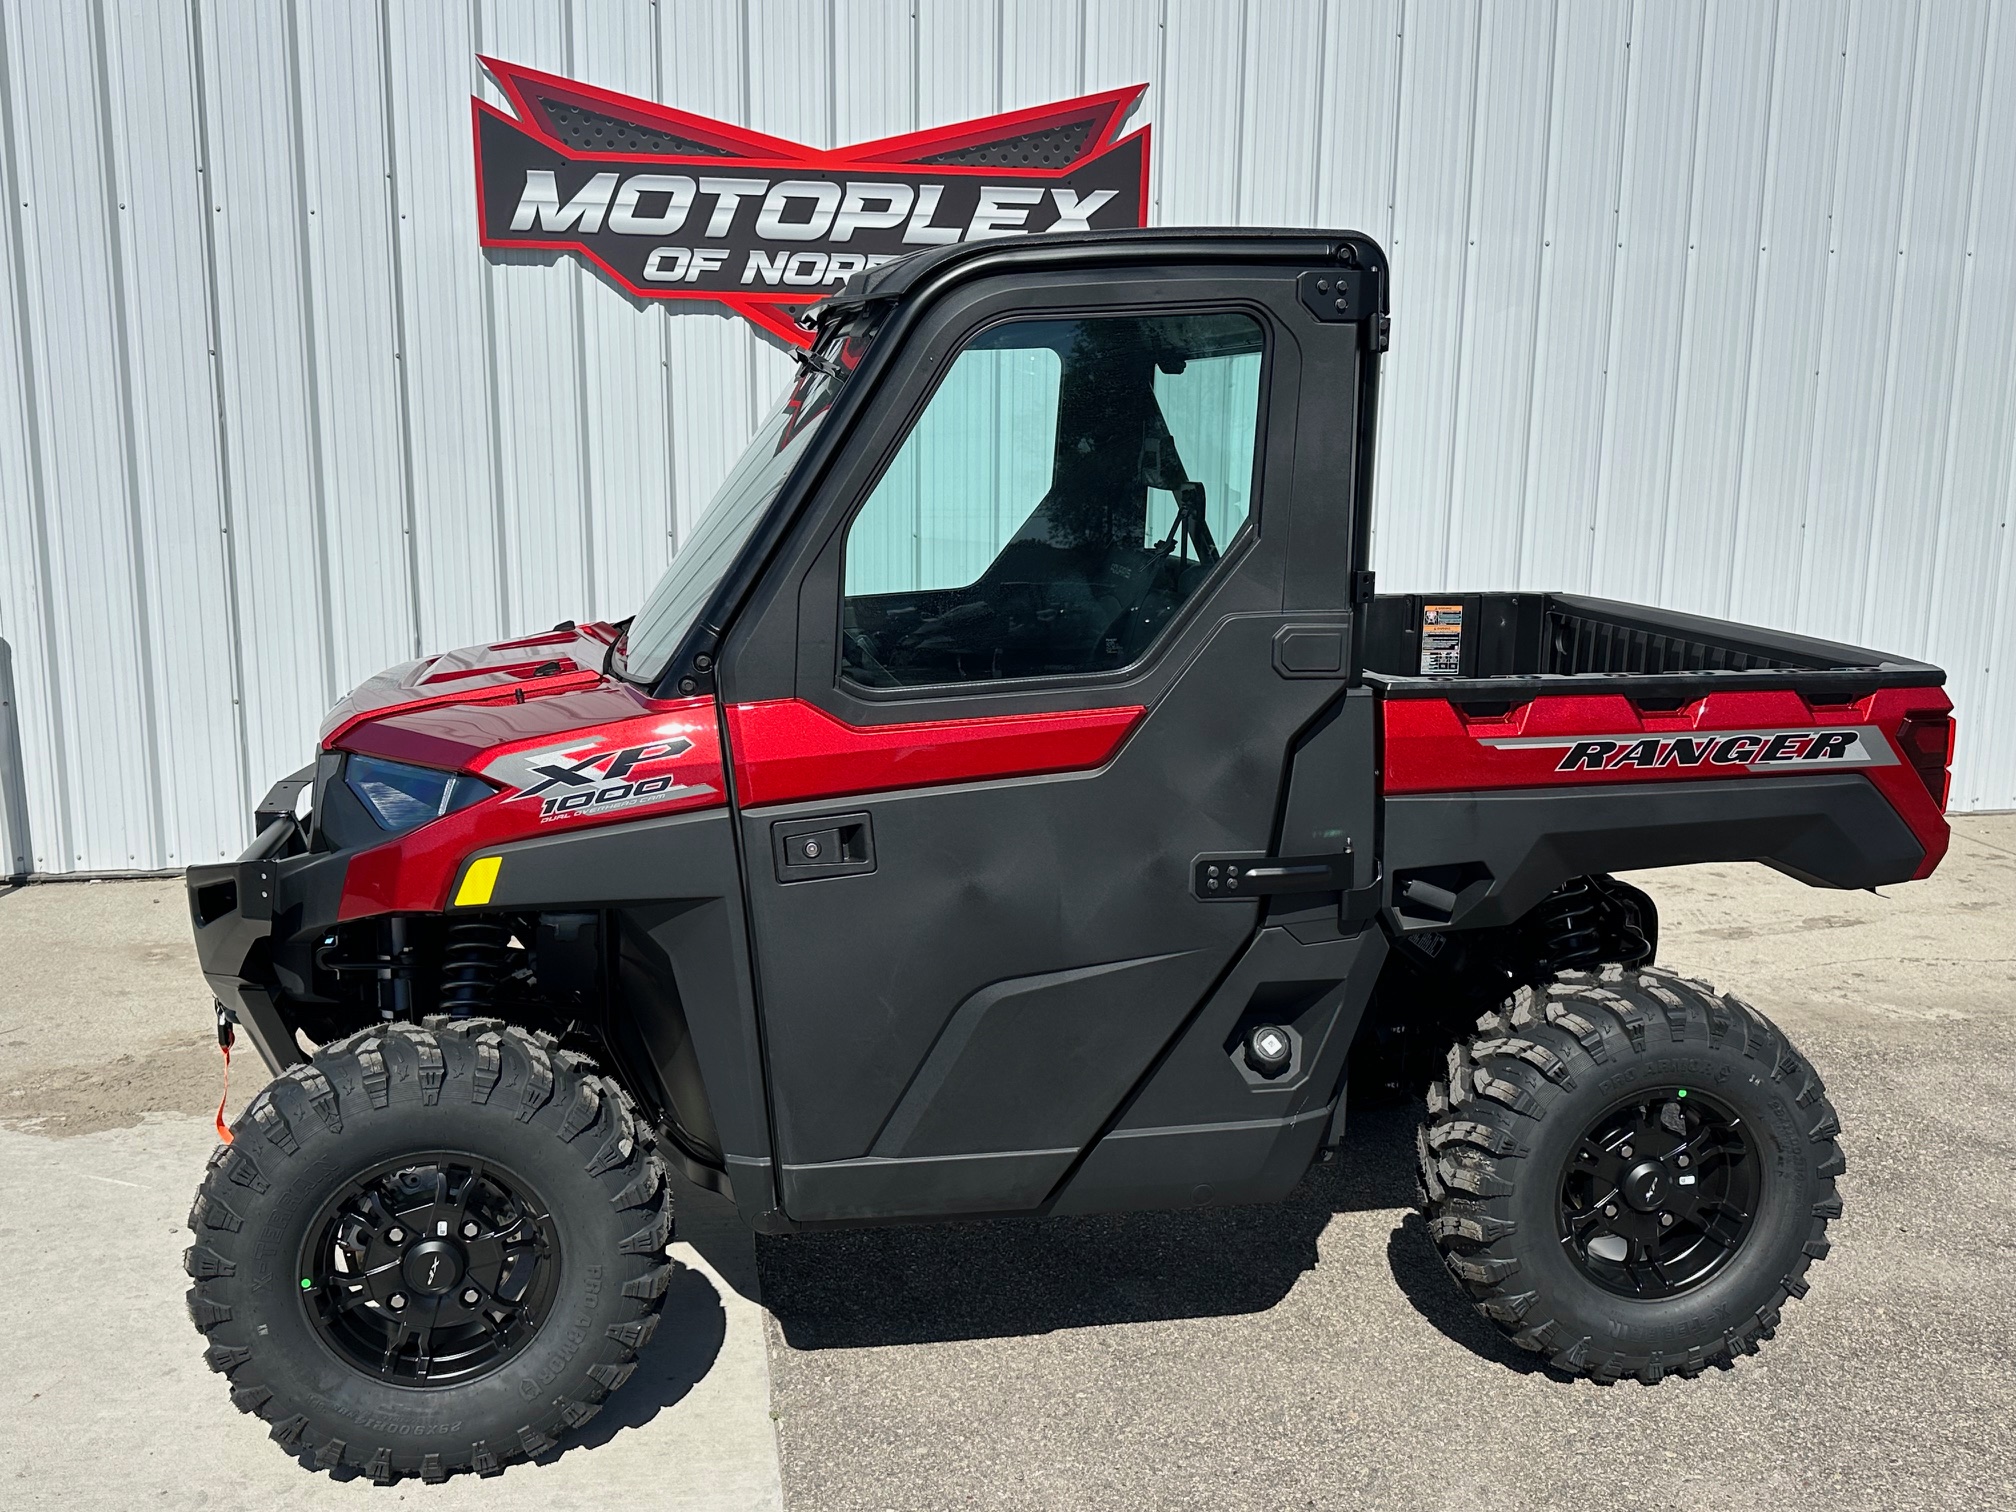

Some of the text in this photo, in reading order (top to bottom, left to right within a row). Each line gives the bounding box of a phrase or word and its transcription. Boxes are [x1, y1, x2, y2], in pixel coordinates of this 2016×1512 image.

[509, 169, 1120, 244] MOTOPLEX
[642, 246, 729, 283] OF
[499, 736, 695, 804] XP
[1555, 730, 1861, 772] RANGER
[539, 774, 673, 817] 1000
[540, 792, 666, 824] DUAL OVERHEAD CAM
[1598, 1057, 1714, 1096] PRO ARMOR
[251, 1153, 340, 1294] X-TERRAIN
[427, 1256, 440, 1286] XP
[537, 1264, 604, 1386] PRO ARMOR
[1607, 1301, 1733, 1344] X-TERRAIN
